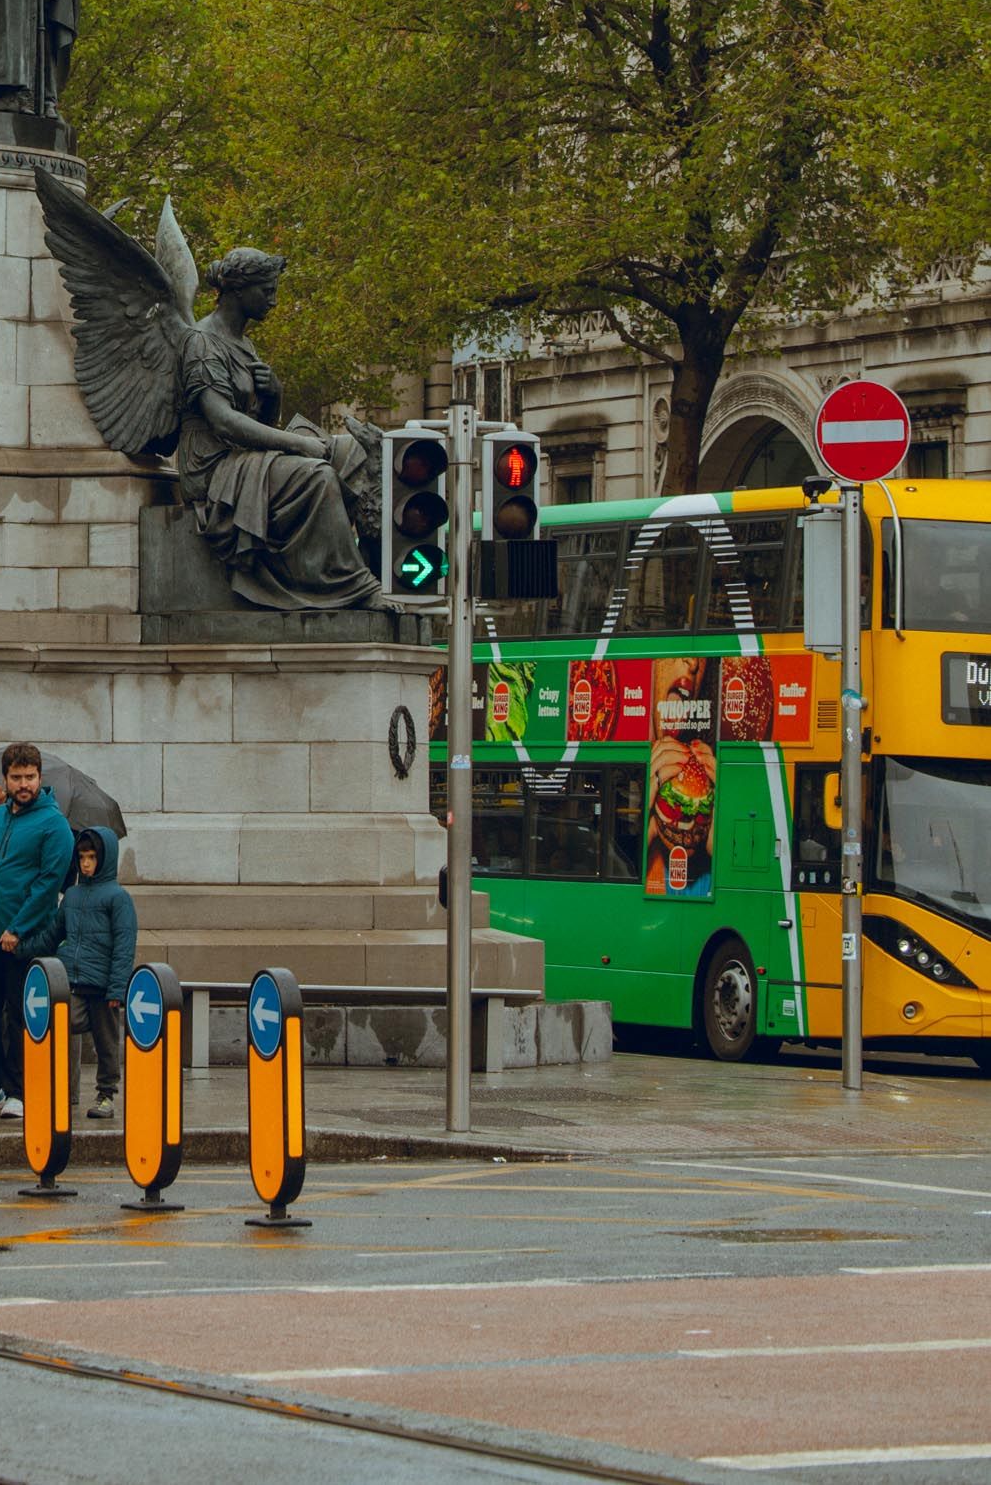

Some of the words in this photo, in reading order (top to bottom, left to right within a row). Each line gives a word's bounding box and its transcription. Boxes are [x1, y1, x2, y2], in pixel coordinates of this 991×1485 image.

[966, 661, 991, 685] Dú
[538, 687, 560, 703] Crispy
[574, 693, 590, 701] BURGER
[623, 686, 643, 699] Fresh
[493, 703, 508, 713] KING
[538, 704, 560, 717] lettuce
[574, 701, 590, 713] KING
[623, 705, 646, 717] tomato
[657, 700, 711, 719] WHOPPER
[727, 700, 743, 712] KING
[691, 722, 697, 730] so
[697, 719, 711, 732] good
[670, 869, 686, 880] KING
